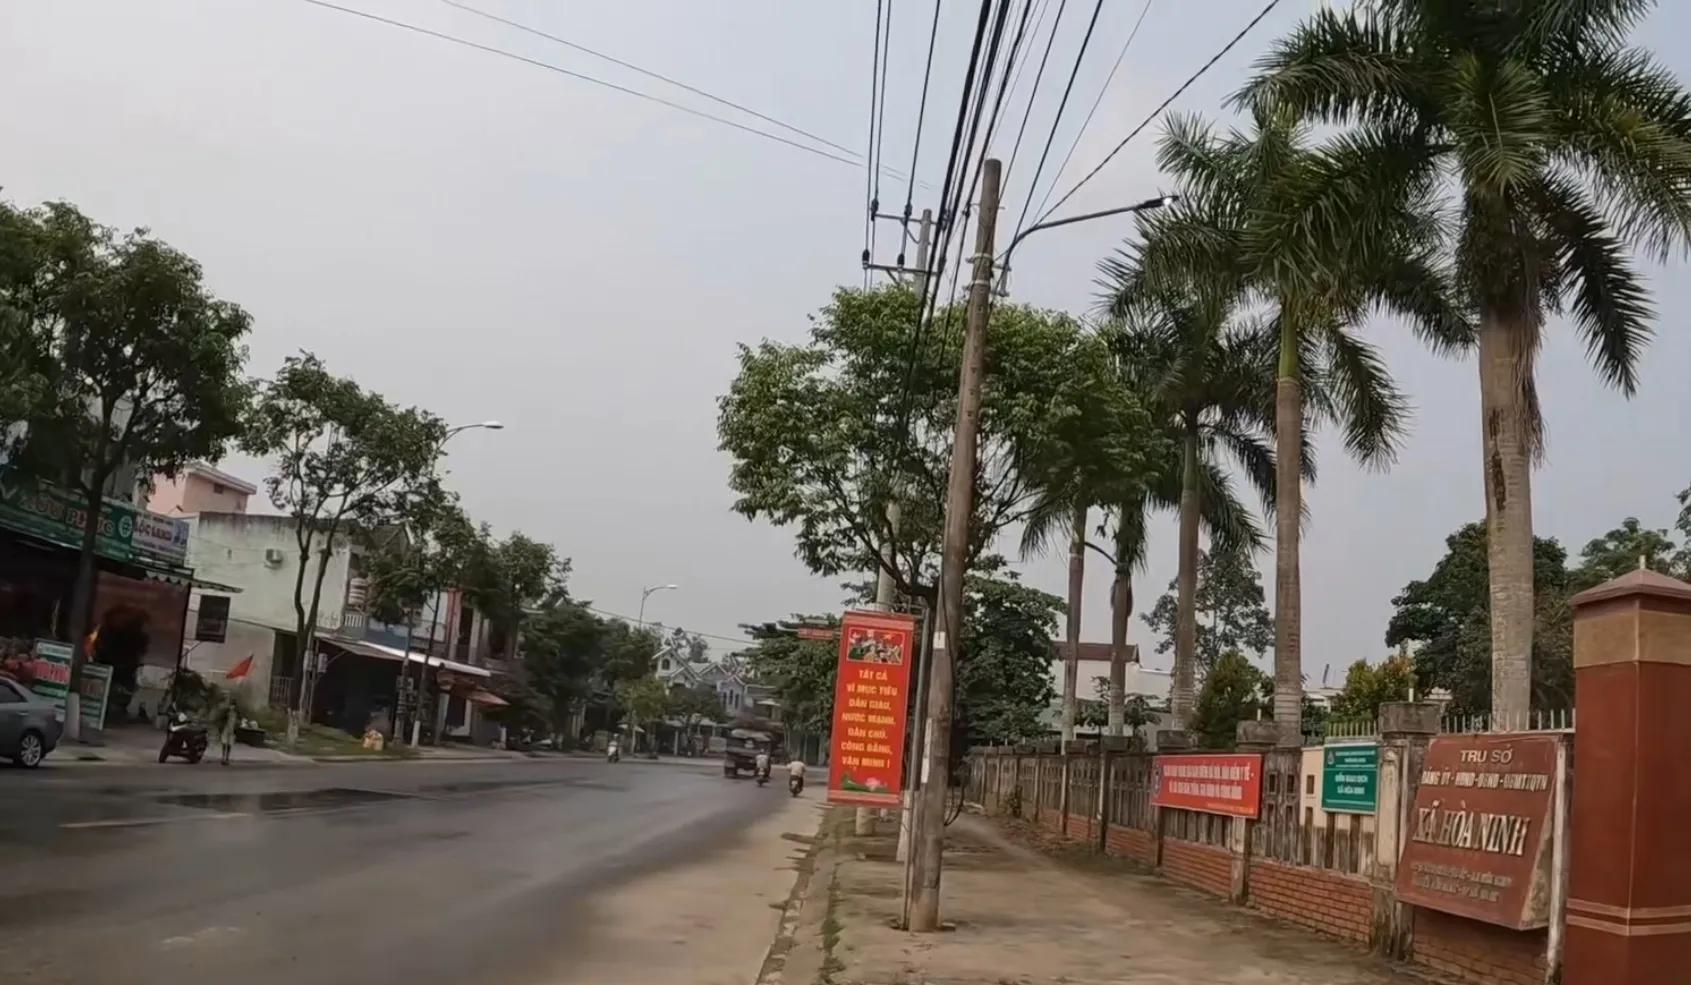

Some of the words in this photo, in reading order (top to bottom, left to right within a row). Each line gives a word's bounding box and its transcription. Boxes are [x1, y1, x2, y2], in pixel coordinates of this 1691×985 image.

[859, 670, 874, 680] TẤT
[876, 671, 888, 680] CẢ
[846, 683, 855, 693] VÌ
[879, 686, 898, 696] TIÊU
[848, 698, 867, 708] DÂN
[847, 728, 866, 738] DÂN
[841, 741, 865, 752] CÔNG
[1459, 750, 1487, 764] TRỤ
[1490, 743, 1513, 763] SỞ
[842, 756, 860, 767] VĂN
[861, 758, 885, 768] MINH
[1412, 800, 1440, 843] XÃ
[1436, 799, 1475, 848] HÒA
[1473, 812, 1531, 856] NINH
